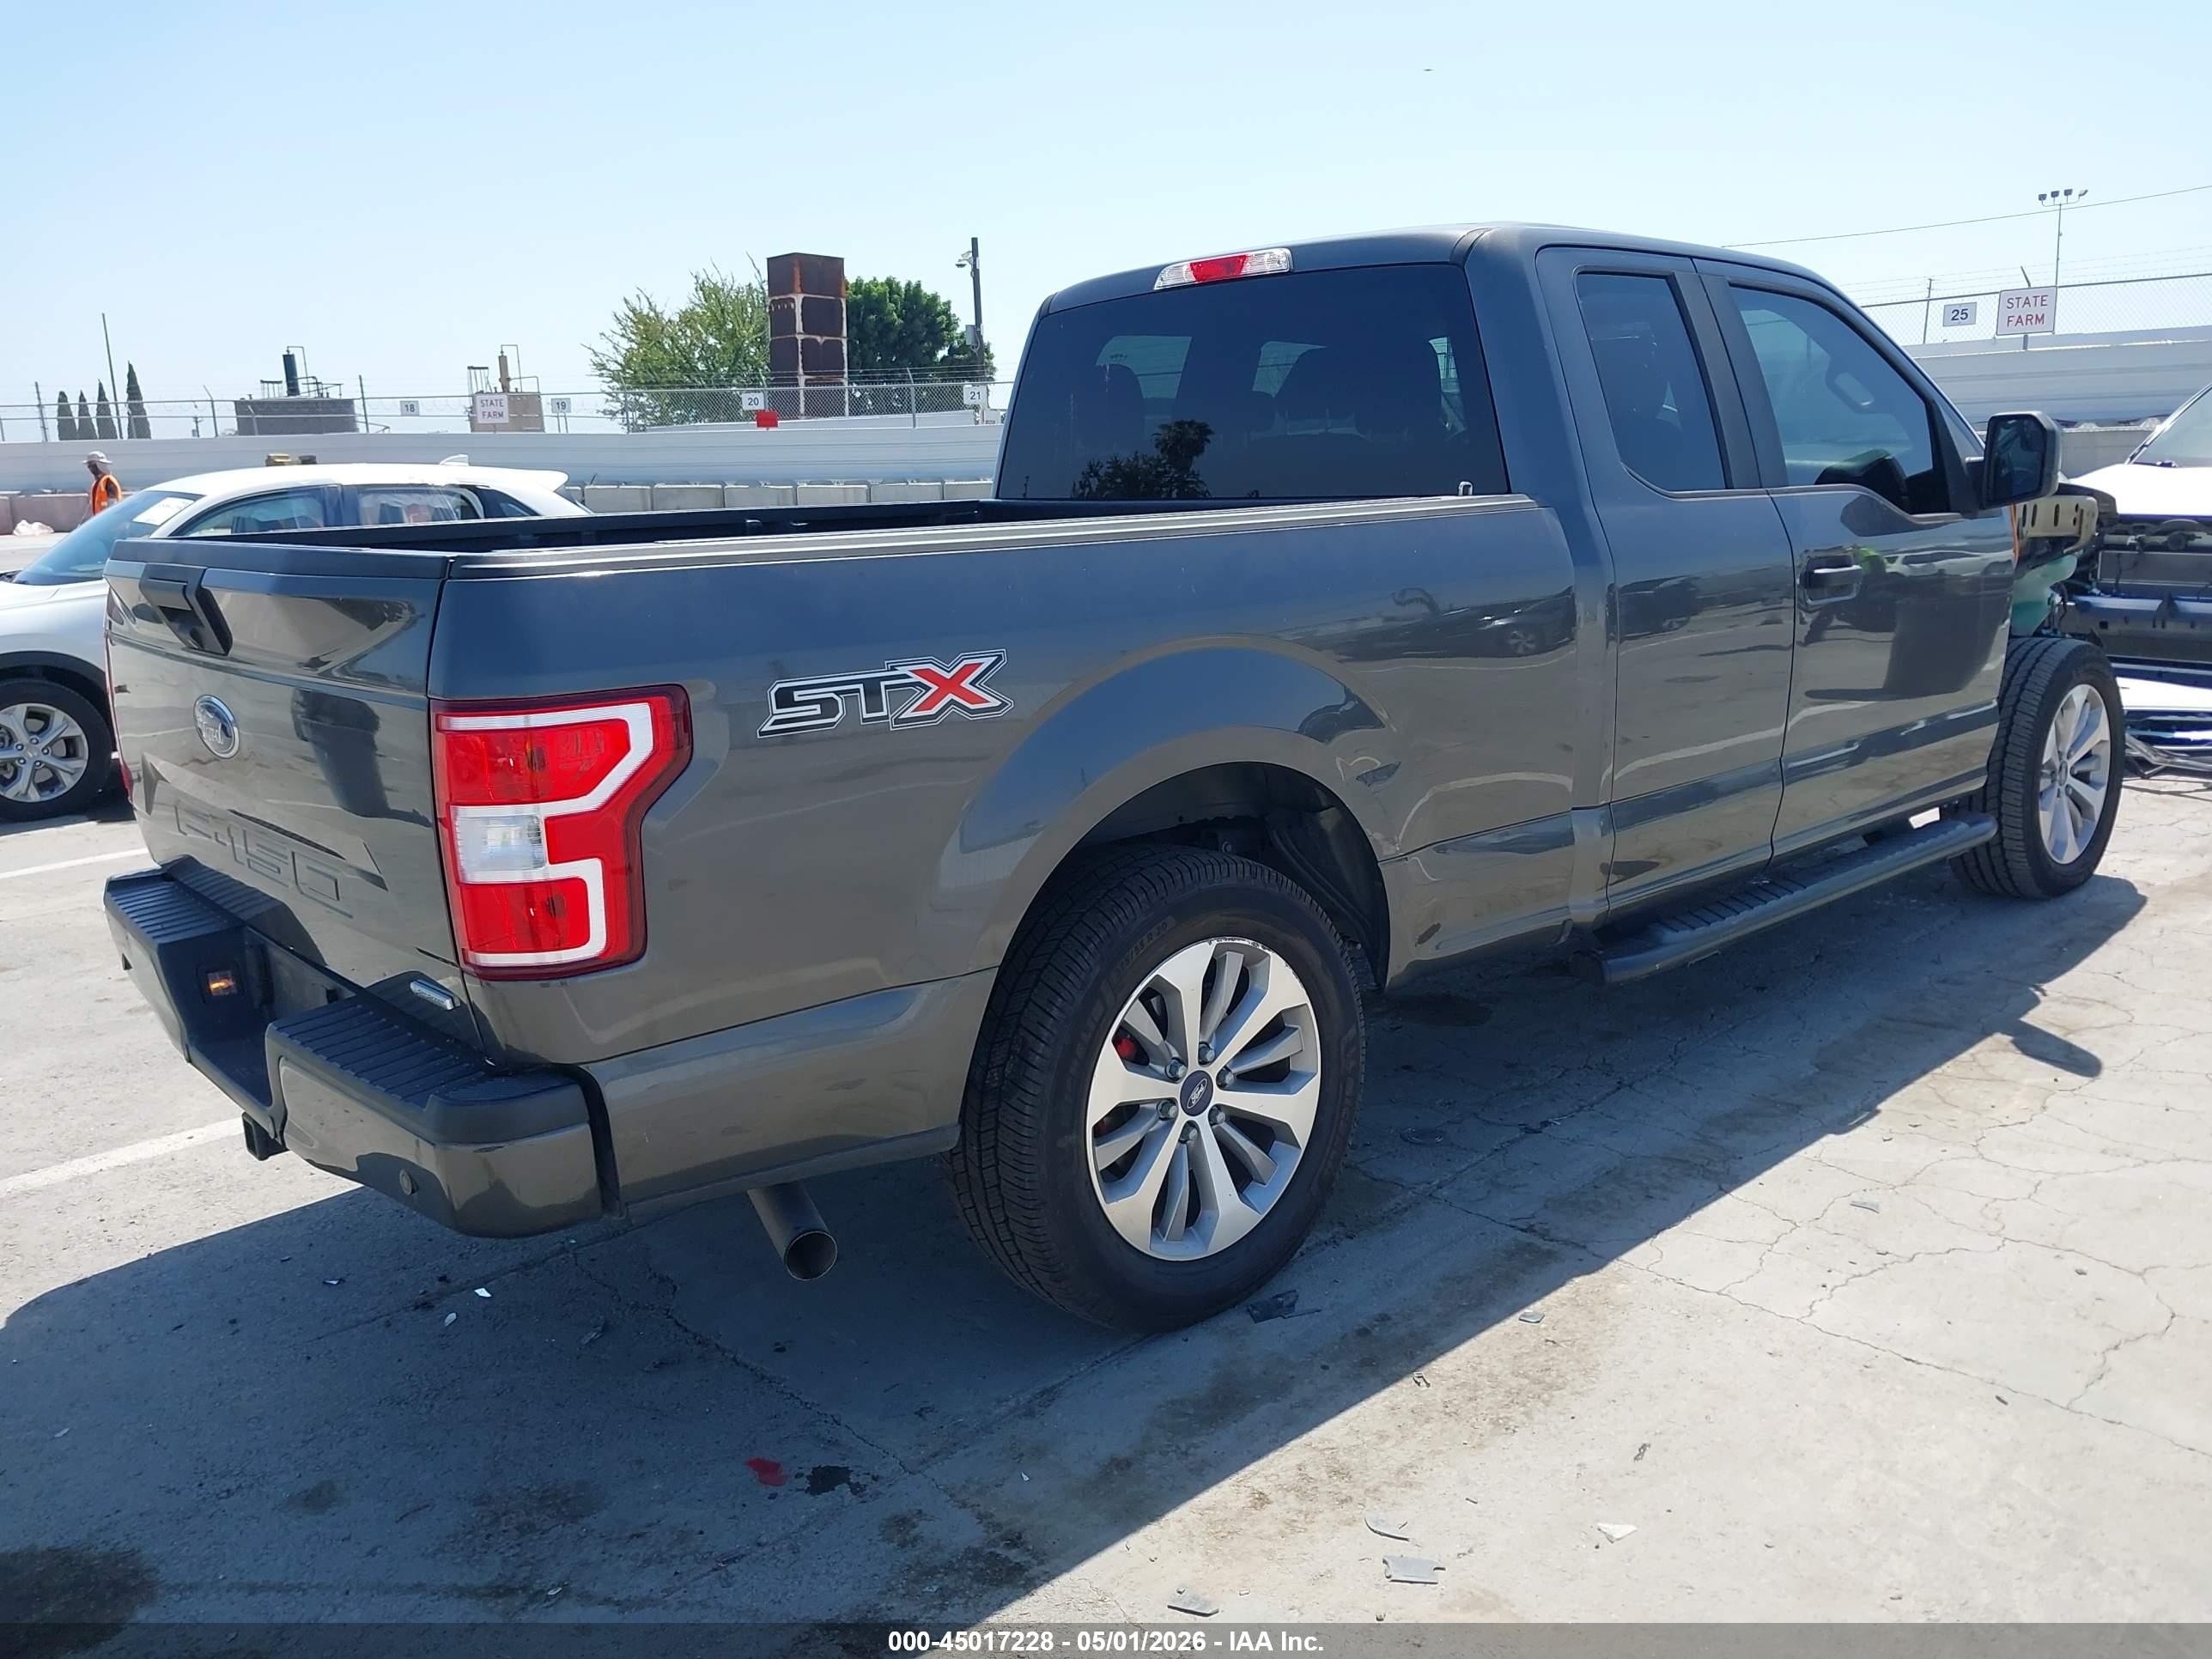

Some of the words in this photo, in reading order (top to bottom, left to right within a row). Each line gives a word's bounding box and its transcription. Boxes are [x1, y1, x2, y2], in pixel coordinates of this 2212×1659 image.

[2006, 295, 2049, 309] STATE
[1950, 308, 1969, 321] 25
[2006, 313, 2045, 327] FARM
[969, 391, 981, 400] 21
[480, 398, 505, 408] STATE
[556, 401, 567, 410] 19
[747, 397, 760, 406] 20
[404, 404, 416, 413] 18
[482, 410, 504, 419] FARM
[757, 648, 1014, 738] STX
